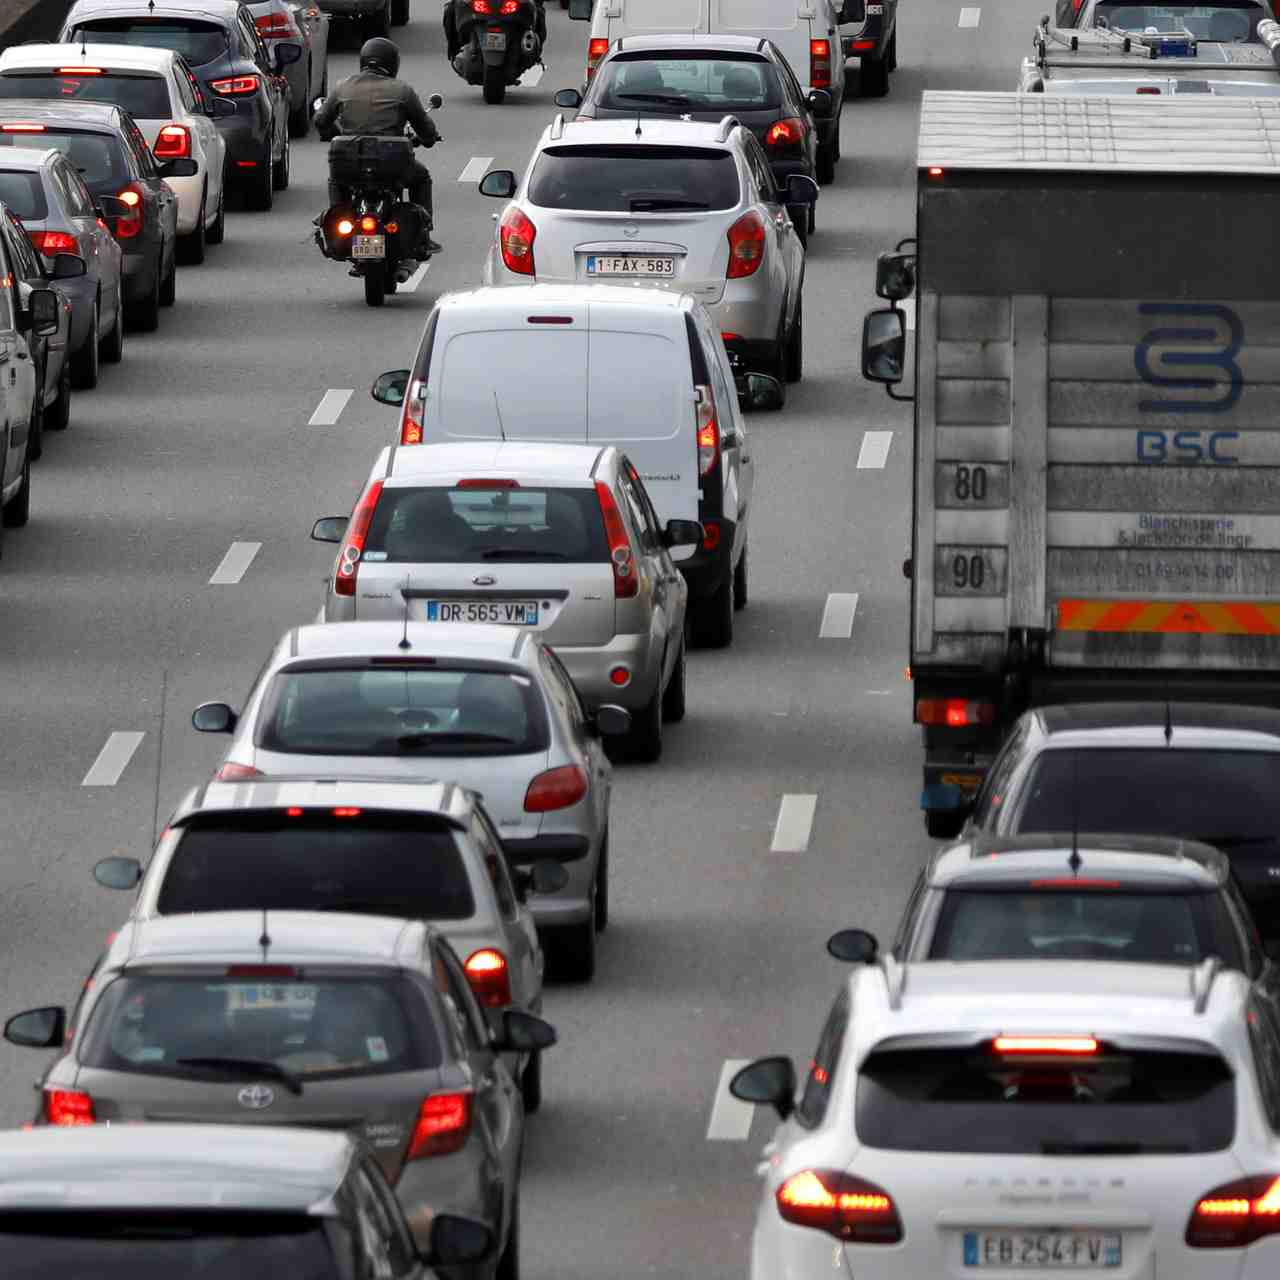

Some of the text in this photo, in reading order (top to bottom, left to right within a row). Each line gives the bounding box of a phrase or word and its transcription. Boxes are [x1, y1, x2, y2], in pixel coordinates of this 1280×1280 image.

[1136, 431, 1239, 464] BSC
[956, 466, 987, 501] 80
[953, 555, 985, 589] 90
